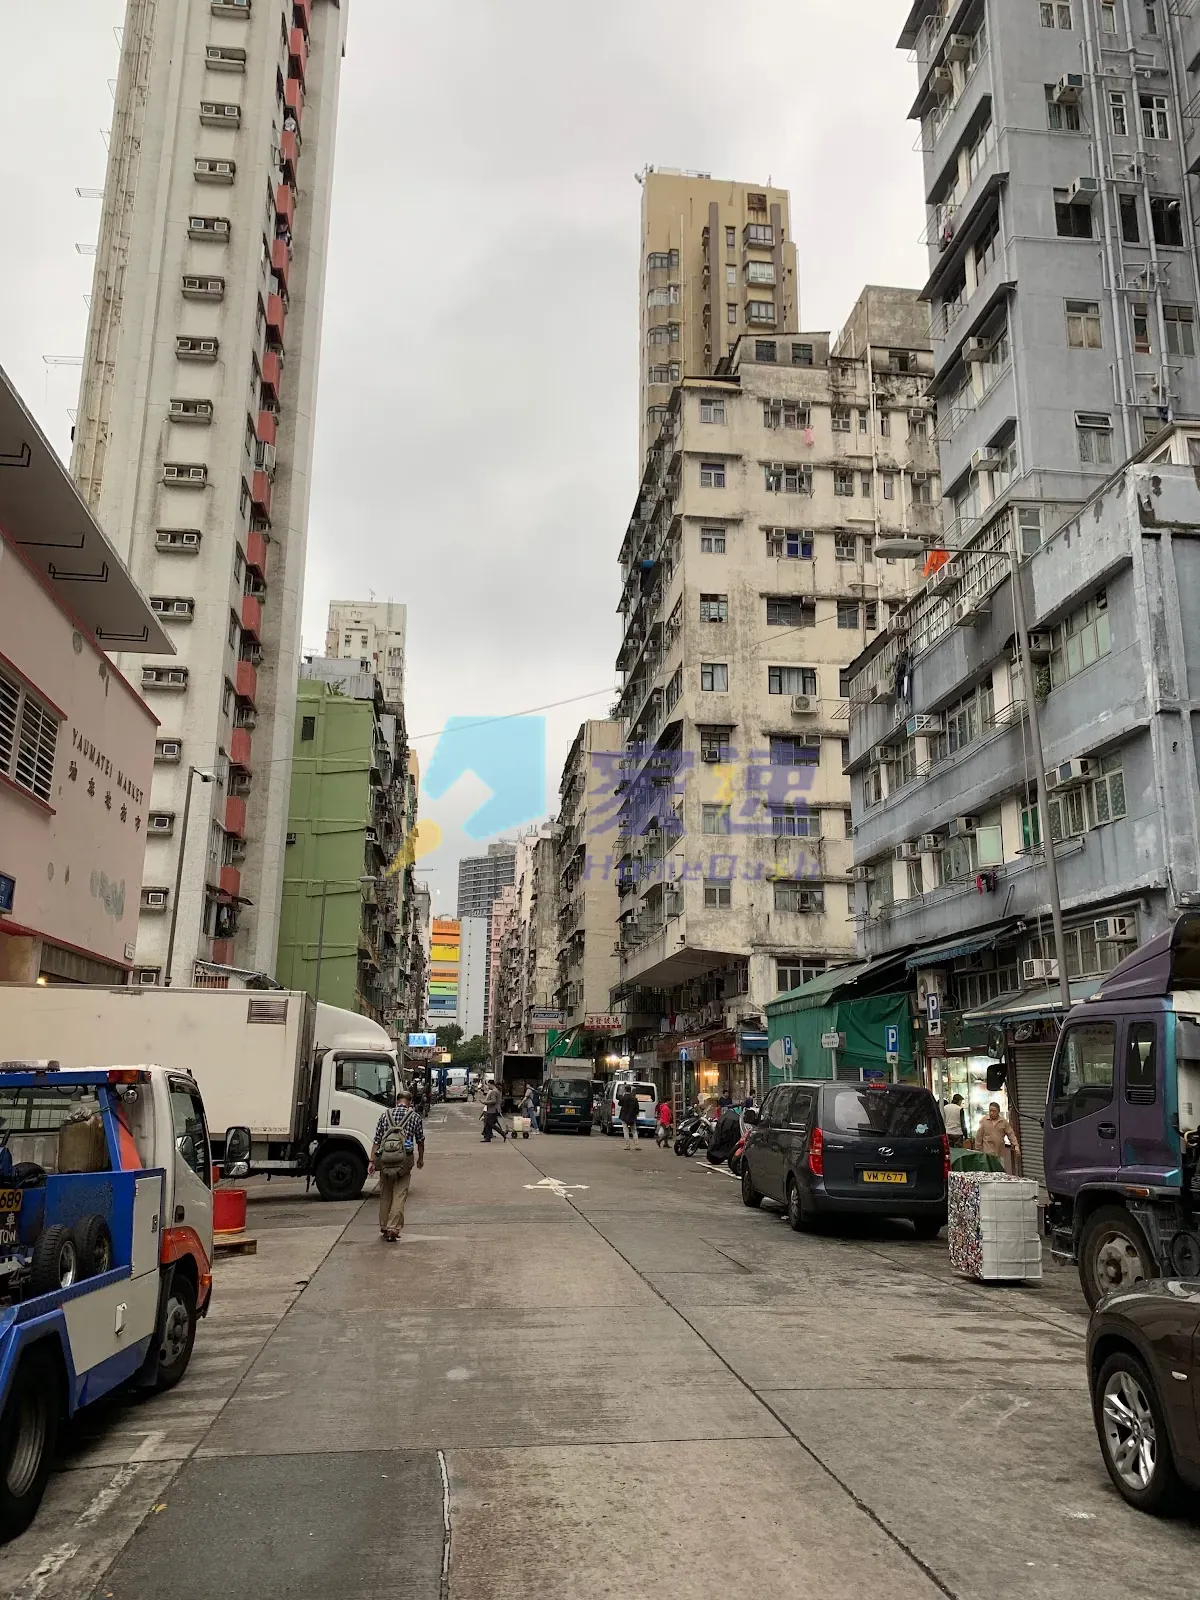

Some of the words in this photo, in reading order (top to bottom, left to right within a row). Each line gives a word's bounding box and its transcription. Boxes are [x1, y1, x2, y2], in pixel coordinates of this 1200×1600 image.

[72, 728, 113, 778] YAUMATEI
[117, 770, 143, 805] MARKET
[928, 995, 937, 1019] P
[785, 1037, 791, 1054] P
[888, 1029, 897, 1051] P
[866, 1172, 879, 1181] VM
[881, 1173, 904, 1182] 7677
